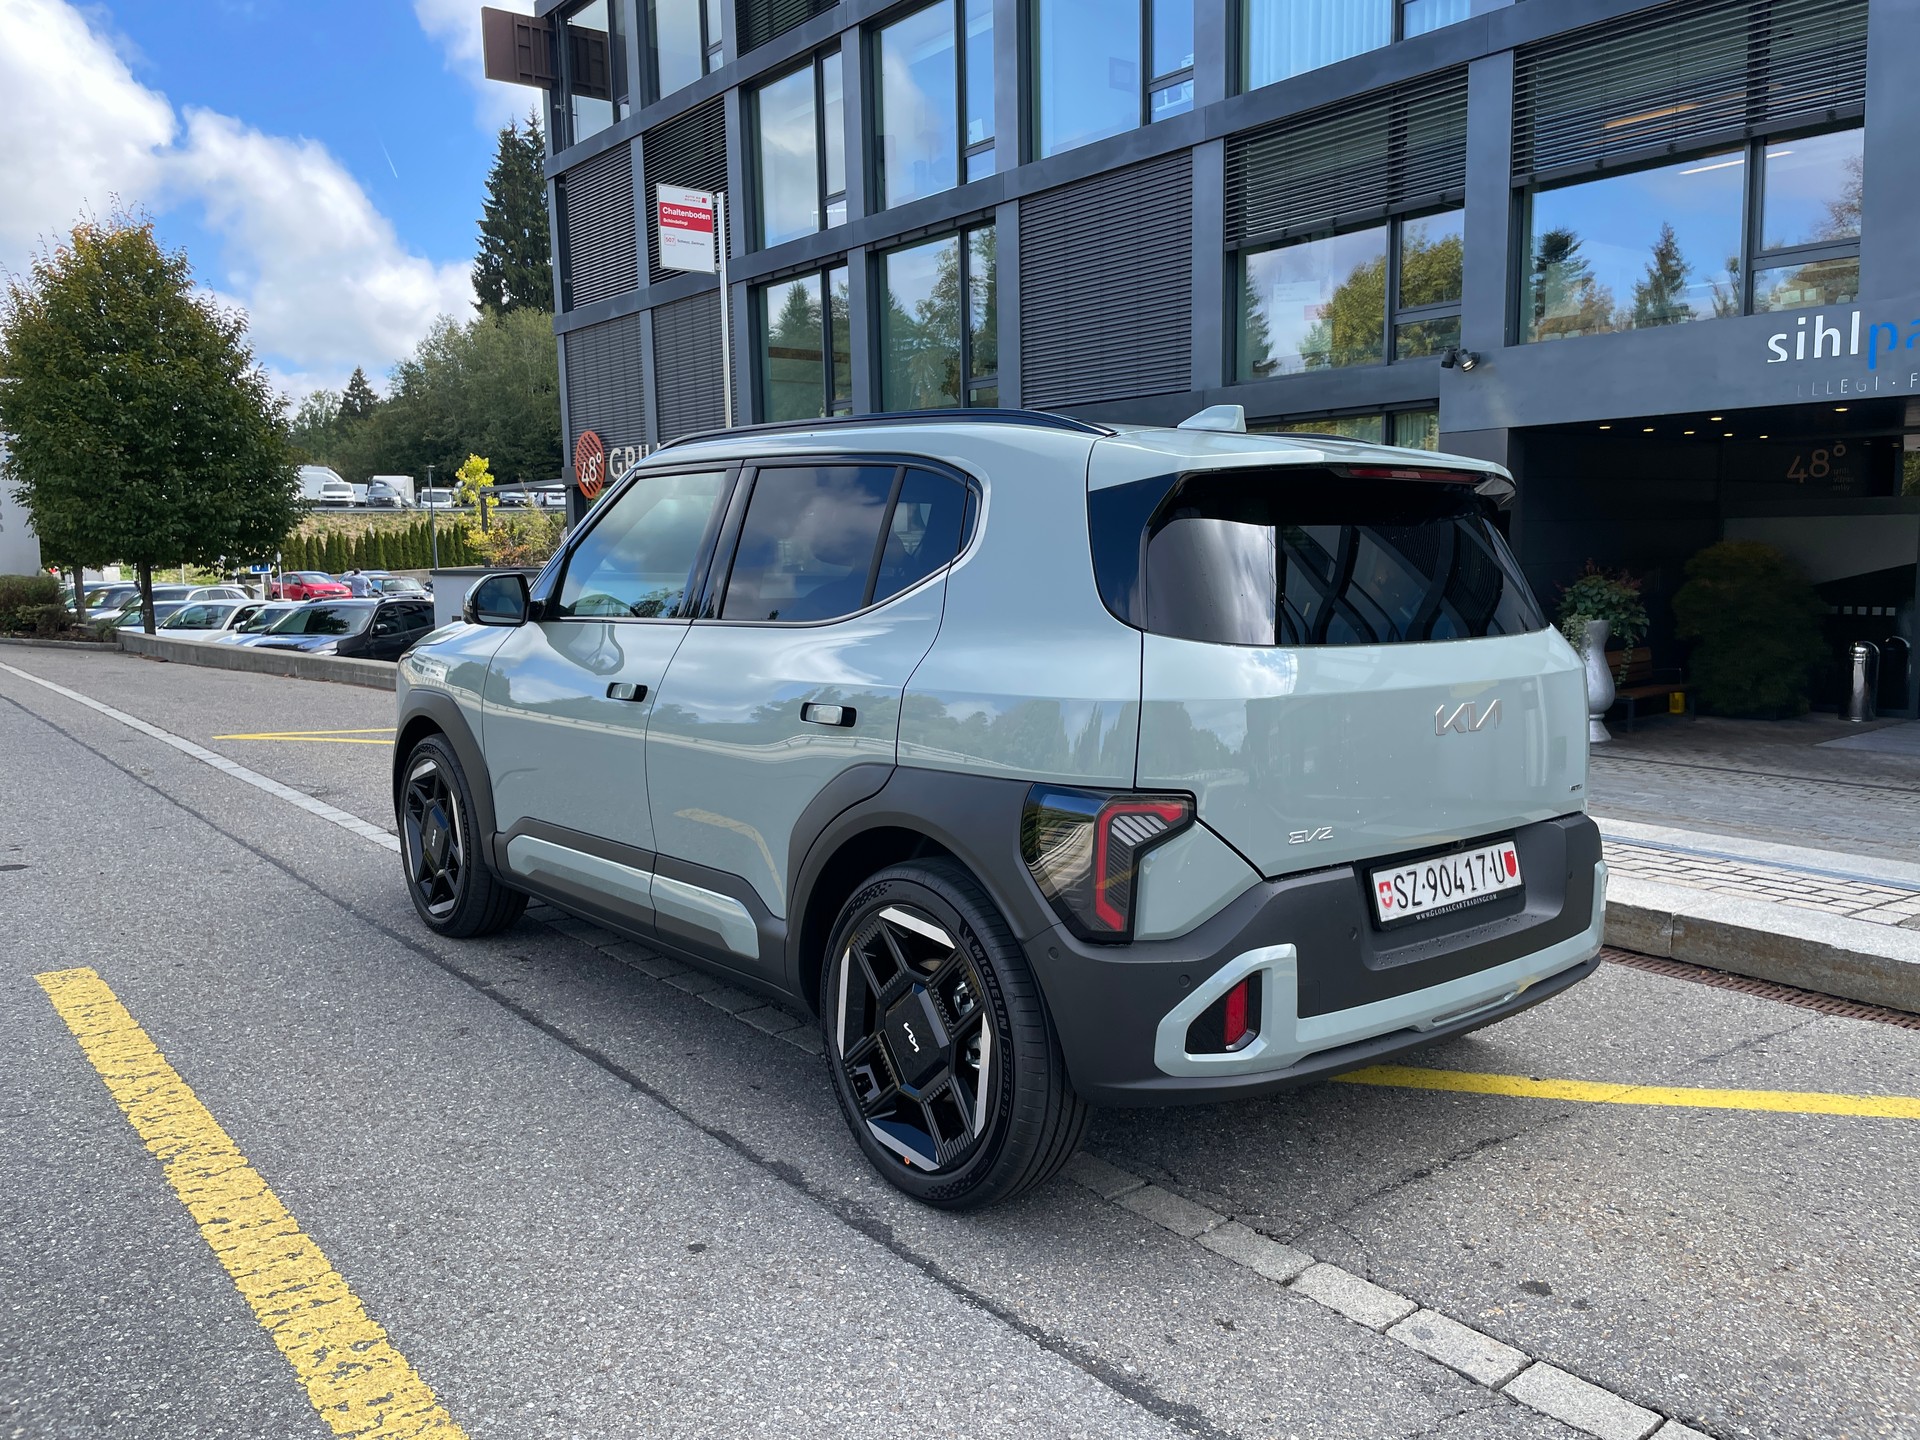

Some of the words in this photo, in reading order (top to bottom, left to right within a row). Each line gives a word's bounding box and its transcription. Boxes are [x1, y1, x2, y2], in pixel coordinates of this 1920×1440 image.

[662, 206, 710, 220] Chaltenboden
[1434, 698, 1502, 736] KIA
[971, 944, 1008, 1030] MICHELIN
